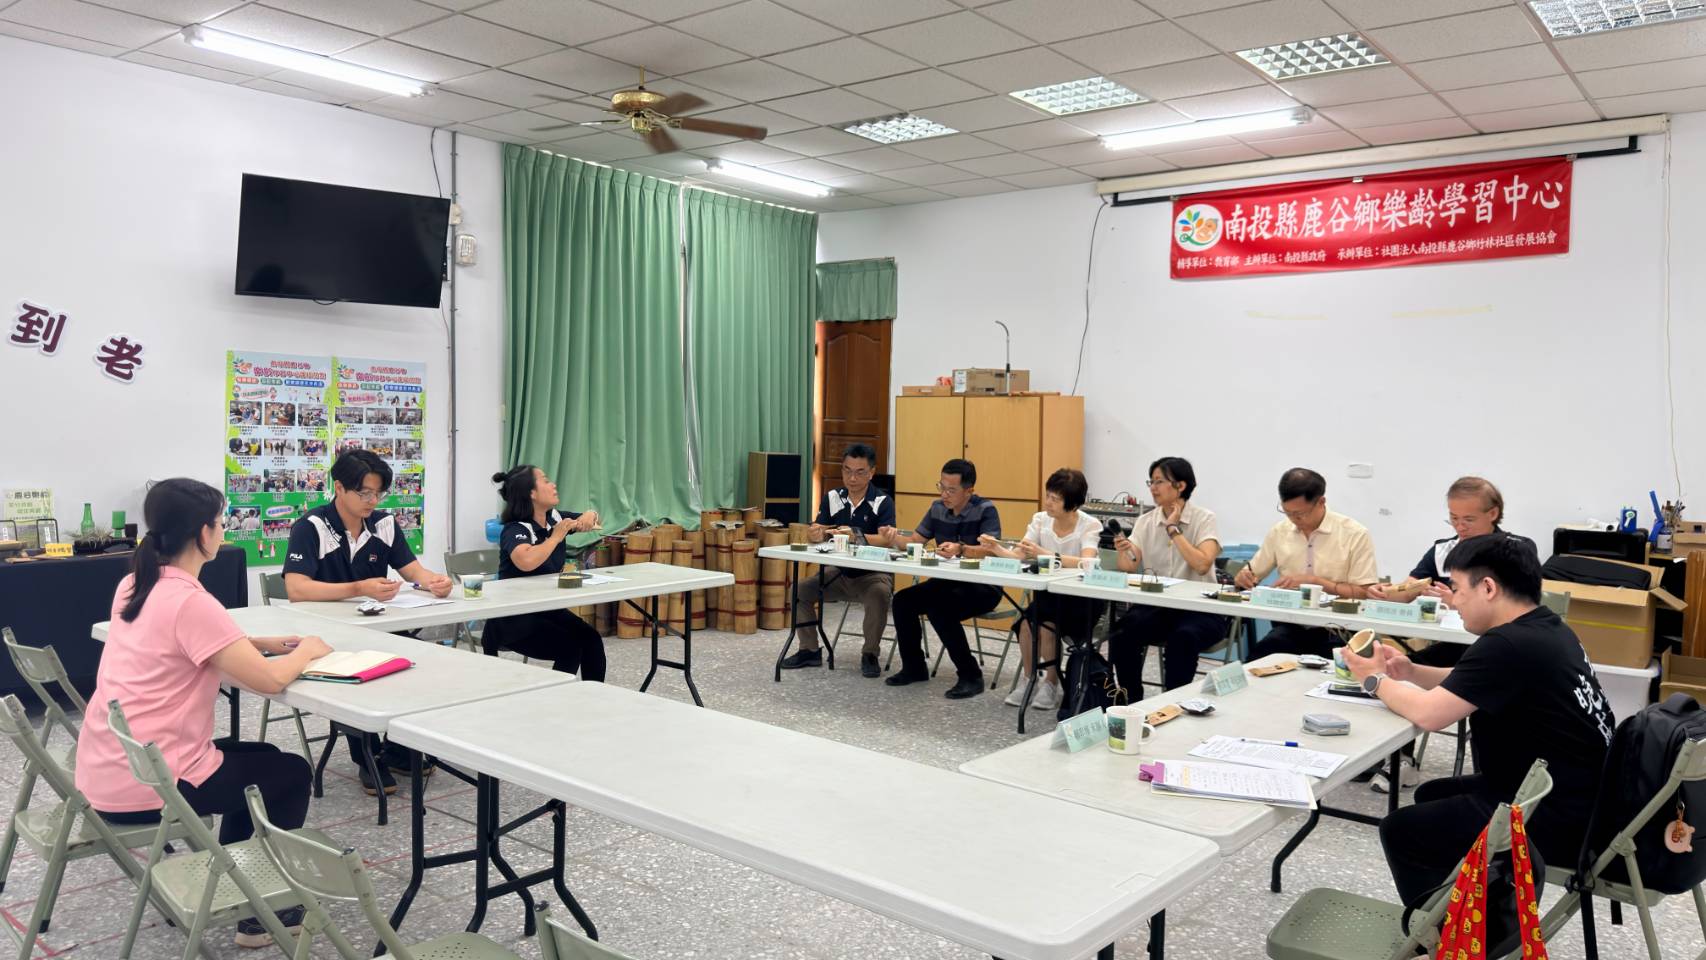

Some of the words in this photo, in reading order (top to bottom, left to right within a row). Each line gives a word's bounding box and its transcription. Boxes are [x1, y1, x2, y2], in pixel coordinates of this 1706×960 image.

[1225, 174, 1563, 243] 南投縣鹿谷鄉樂齡學習中心
[11, 302, 67, 353] 到
[97, 336, 142, 380] 老
